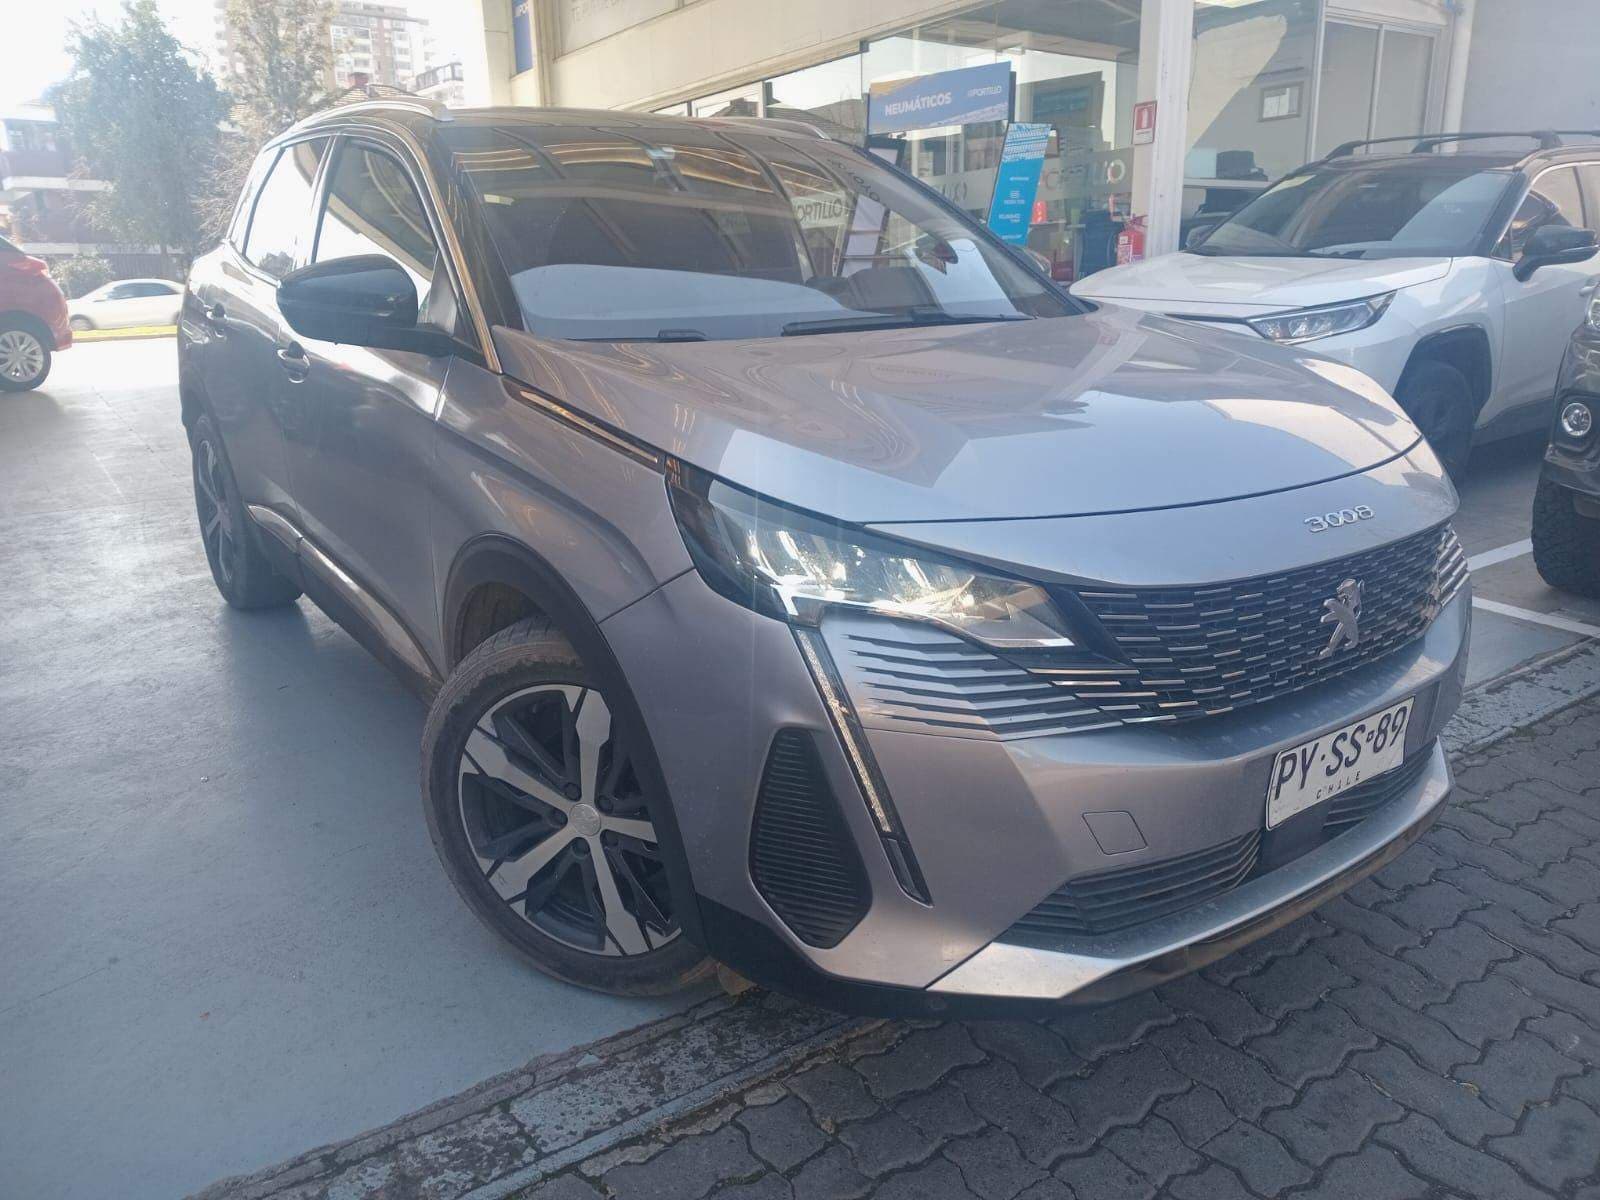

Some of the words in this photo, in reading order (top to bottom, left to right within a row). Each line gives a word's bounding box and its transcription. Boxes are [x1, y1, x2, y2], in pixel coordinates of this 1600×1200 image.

[885, 91, 952, 116] NEUMÁTICOS
[1304, 504, 1375, 533] 3008
[1316, 770, 1361, 799] CHILE
